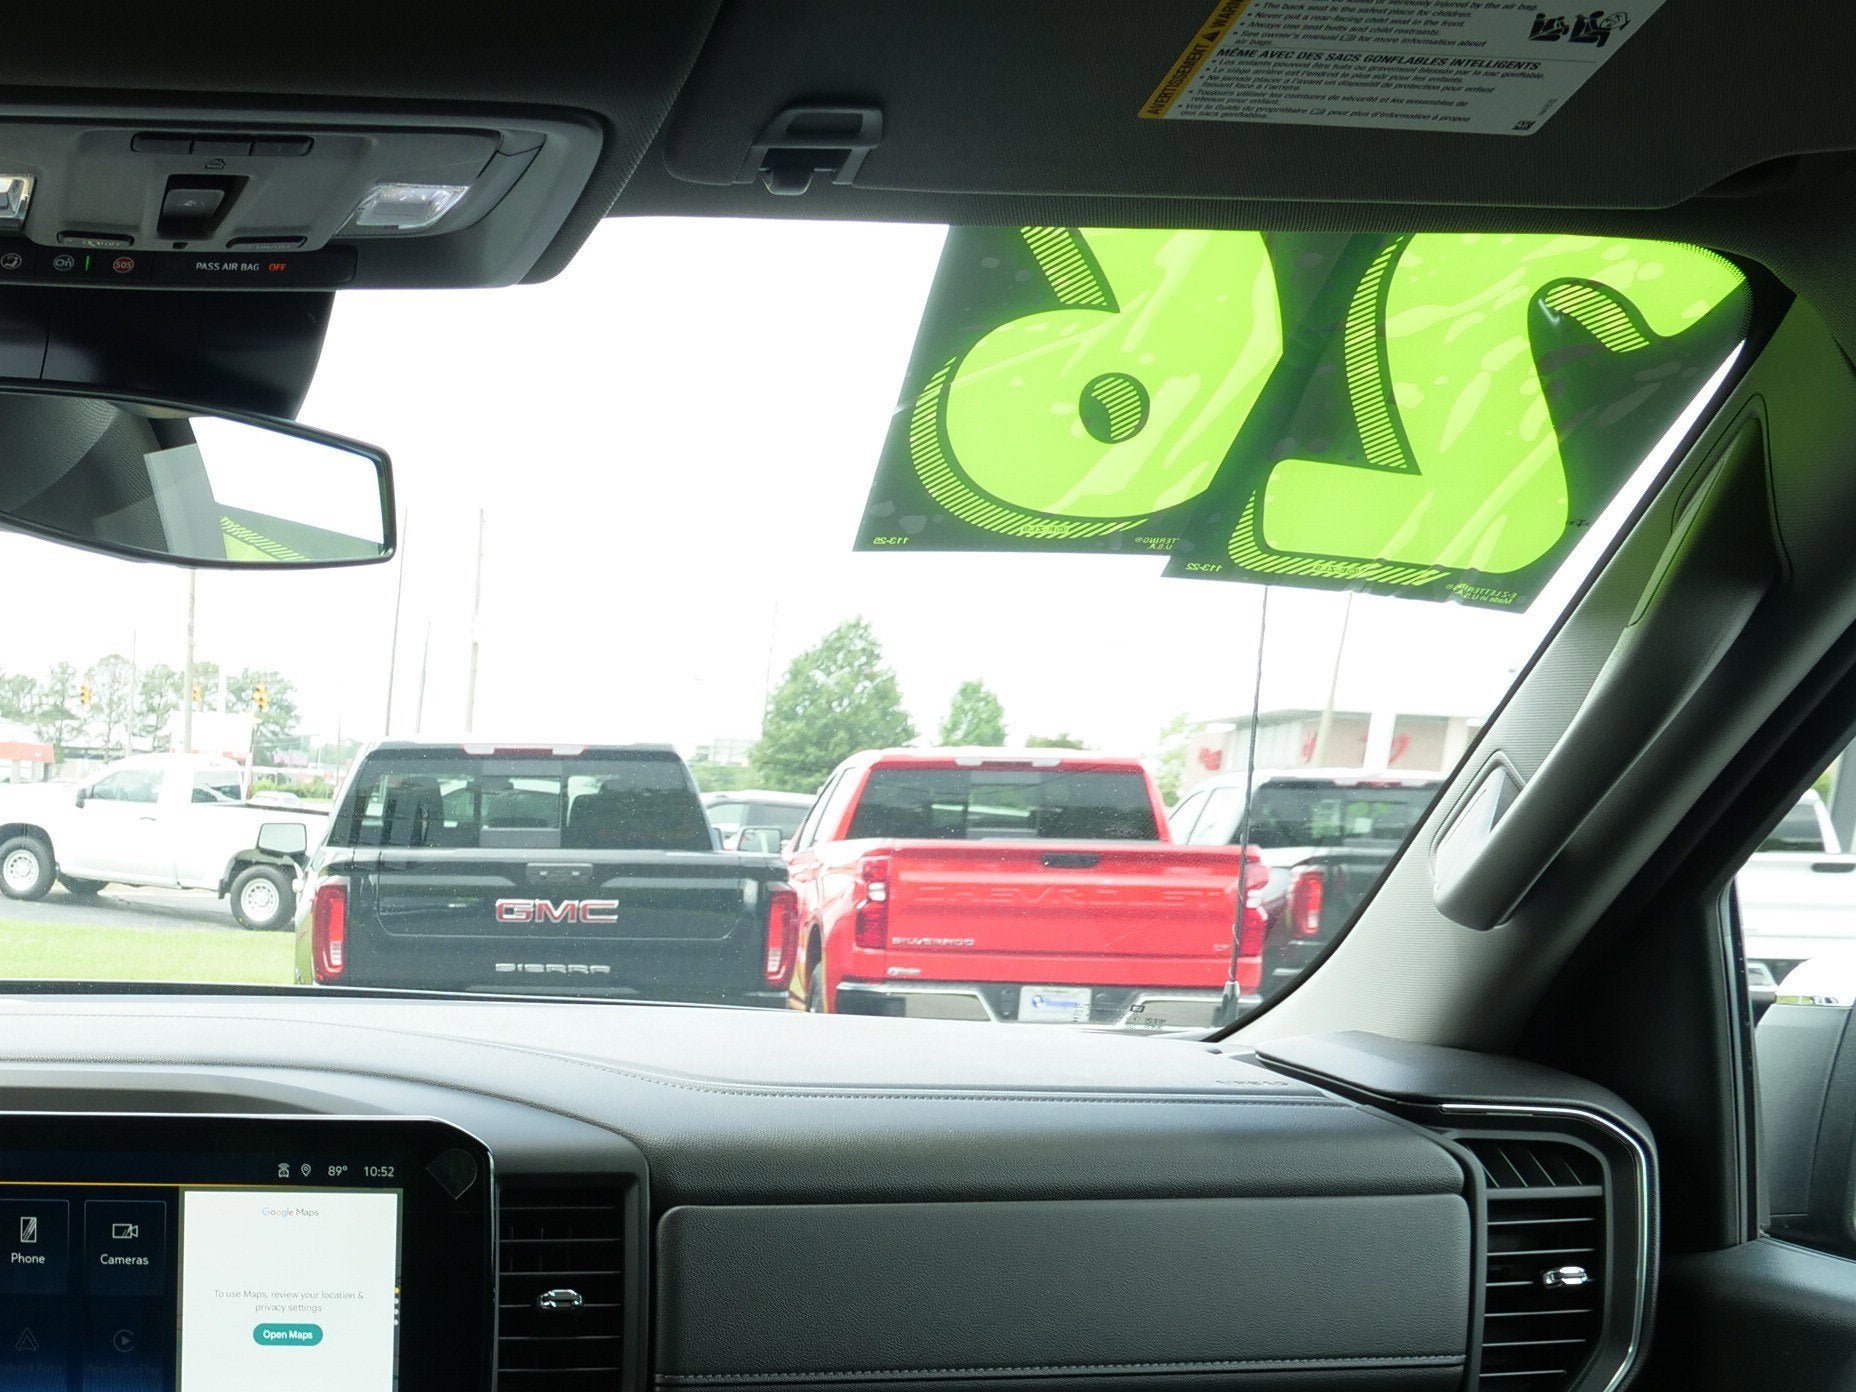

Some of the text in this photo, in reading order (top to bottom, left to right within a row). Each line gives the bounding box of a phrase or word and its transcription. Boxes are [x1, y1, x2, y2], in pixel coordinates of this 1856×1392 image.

[1258, 51, 1294, 59] AVEC
[1297, 52, 1323, 61] DES
[1325, 53, 1361, 62] SACS
[1363, 54, 1447, 66] GONFLABLES
[1449, 58, 1542, 70] INTELLIGENTS
[195, 261, 287, 271] PASS AIR BAG OFF
[495, 898, 619, 923] GMC
[495, 963, 611, 974] SIERRA
[363, 1166, 394, 1178] 10:52
[262, 1207, 319, 1218] Google Maps
[11, 1252, 46, 1264] Phone
[100, 1254, 149, 1265] Cameras
[214, 1289, 224, 1298] To
[243, 1290, 269, 1300] Maps,
[271, 1291, 298, 1299] review
[300, 1292, 319, 1301] your
[321, 1291, 355, 1300] location
[357, 1291, 364, 1300] &
[255, 1303, 322, 1314] privacy settings
[263, 1329, 313, 1340] Open Maps
